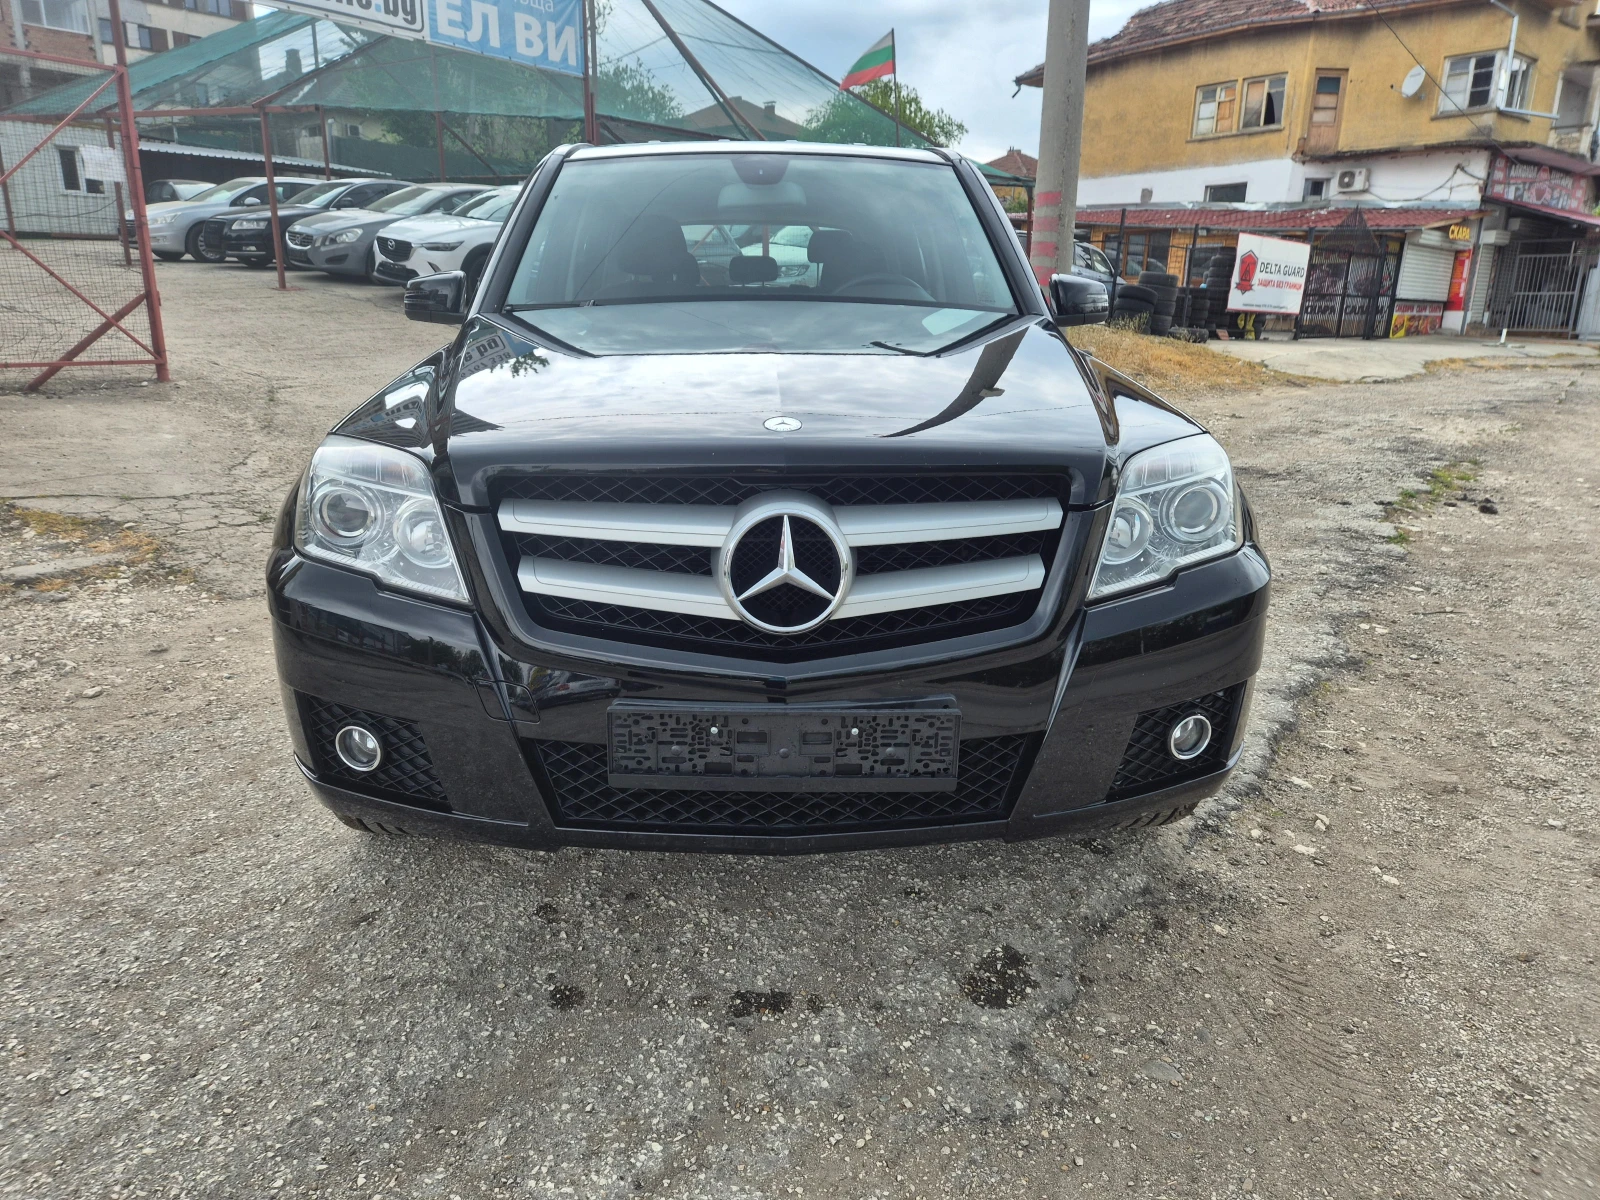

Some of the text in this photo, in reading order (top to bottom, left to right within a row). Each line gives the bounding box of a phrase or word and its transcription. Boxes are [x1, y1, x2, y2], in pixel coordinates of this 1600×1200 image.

[435, 0, 577, 67] ЕЛ ВИ
[1448, 224, 1471, 240] СКАРА
[1259, 261, 1305, 278] DELTA GUARD
[1257, 278, 1276, 288] ЗАЩИТА
